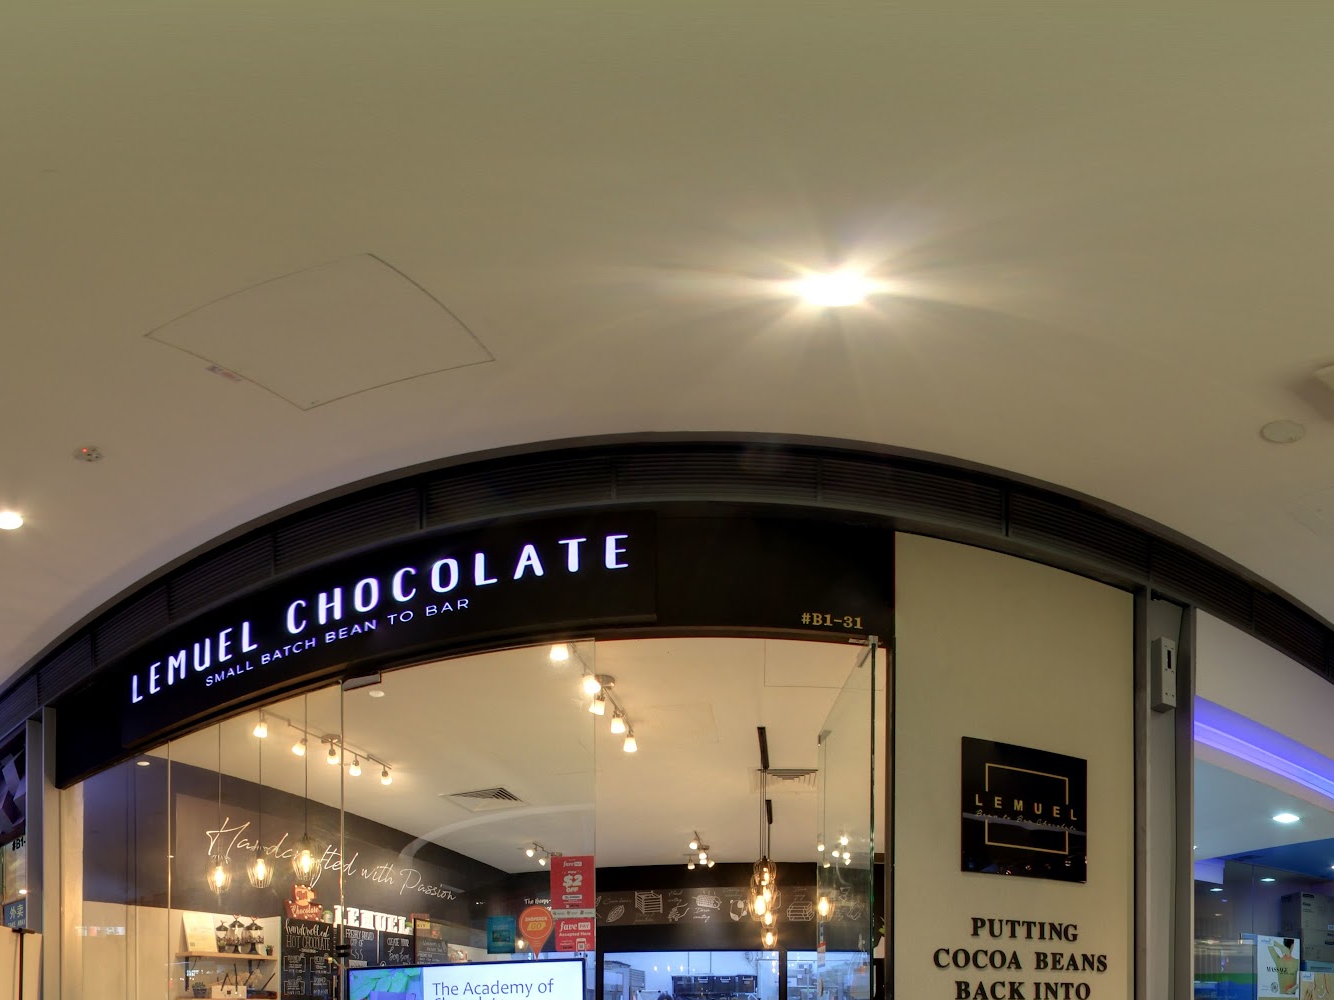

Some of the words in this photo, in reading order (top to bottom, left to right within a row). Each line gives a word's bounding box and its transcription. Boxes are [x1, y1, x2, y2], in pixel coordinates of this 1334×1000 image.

[131, 621, 258, 704] LEMUEL
[286, 534, 629, 634] CHOCOLATE
[801, 612, 863, 629] #B1-31
[205, 660, 254, 687] SMALL
[261, 637, 316, 665] BATCH
[324, 619, 377, 644] BEAN
[387, 610, 414, 625] TO
[425, 598, 469, 617] BAR
[975, 793, 1077, 821] LEMUEL
[361, 862, 395, 885] with
[399, 868, 457, 901] Passion
[563, 874, 583, 887] $2
[10, 904, 24, 919] 外卖
[290, 905, 319, 915] Chocolate
[333, 905, 411, 935] LEMUEL
[559, 921, 577, 932] fave
[970, 917, 1079, 942] PUTTING
[286, 935, 302, 948] HOT
[302, 936, 330, 951] CHOCOLATE
[933, 948, 1022, 969] COCOA
[1034, 951, 1108, 972] BEANS
[432, 982, 459, 996] The
[463, 980, 533, 997] Academy
[538, 978, 554, 993] of
[955, 980, 1025, 1000] BACK
[1033, 982, 1091, 1000] INTO
